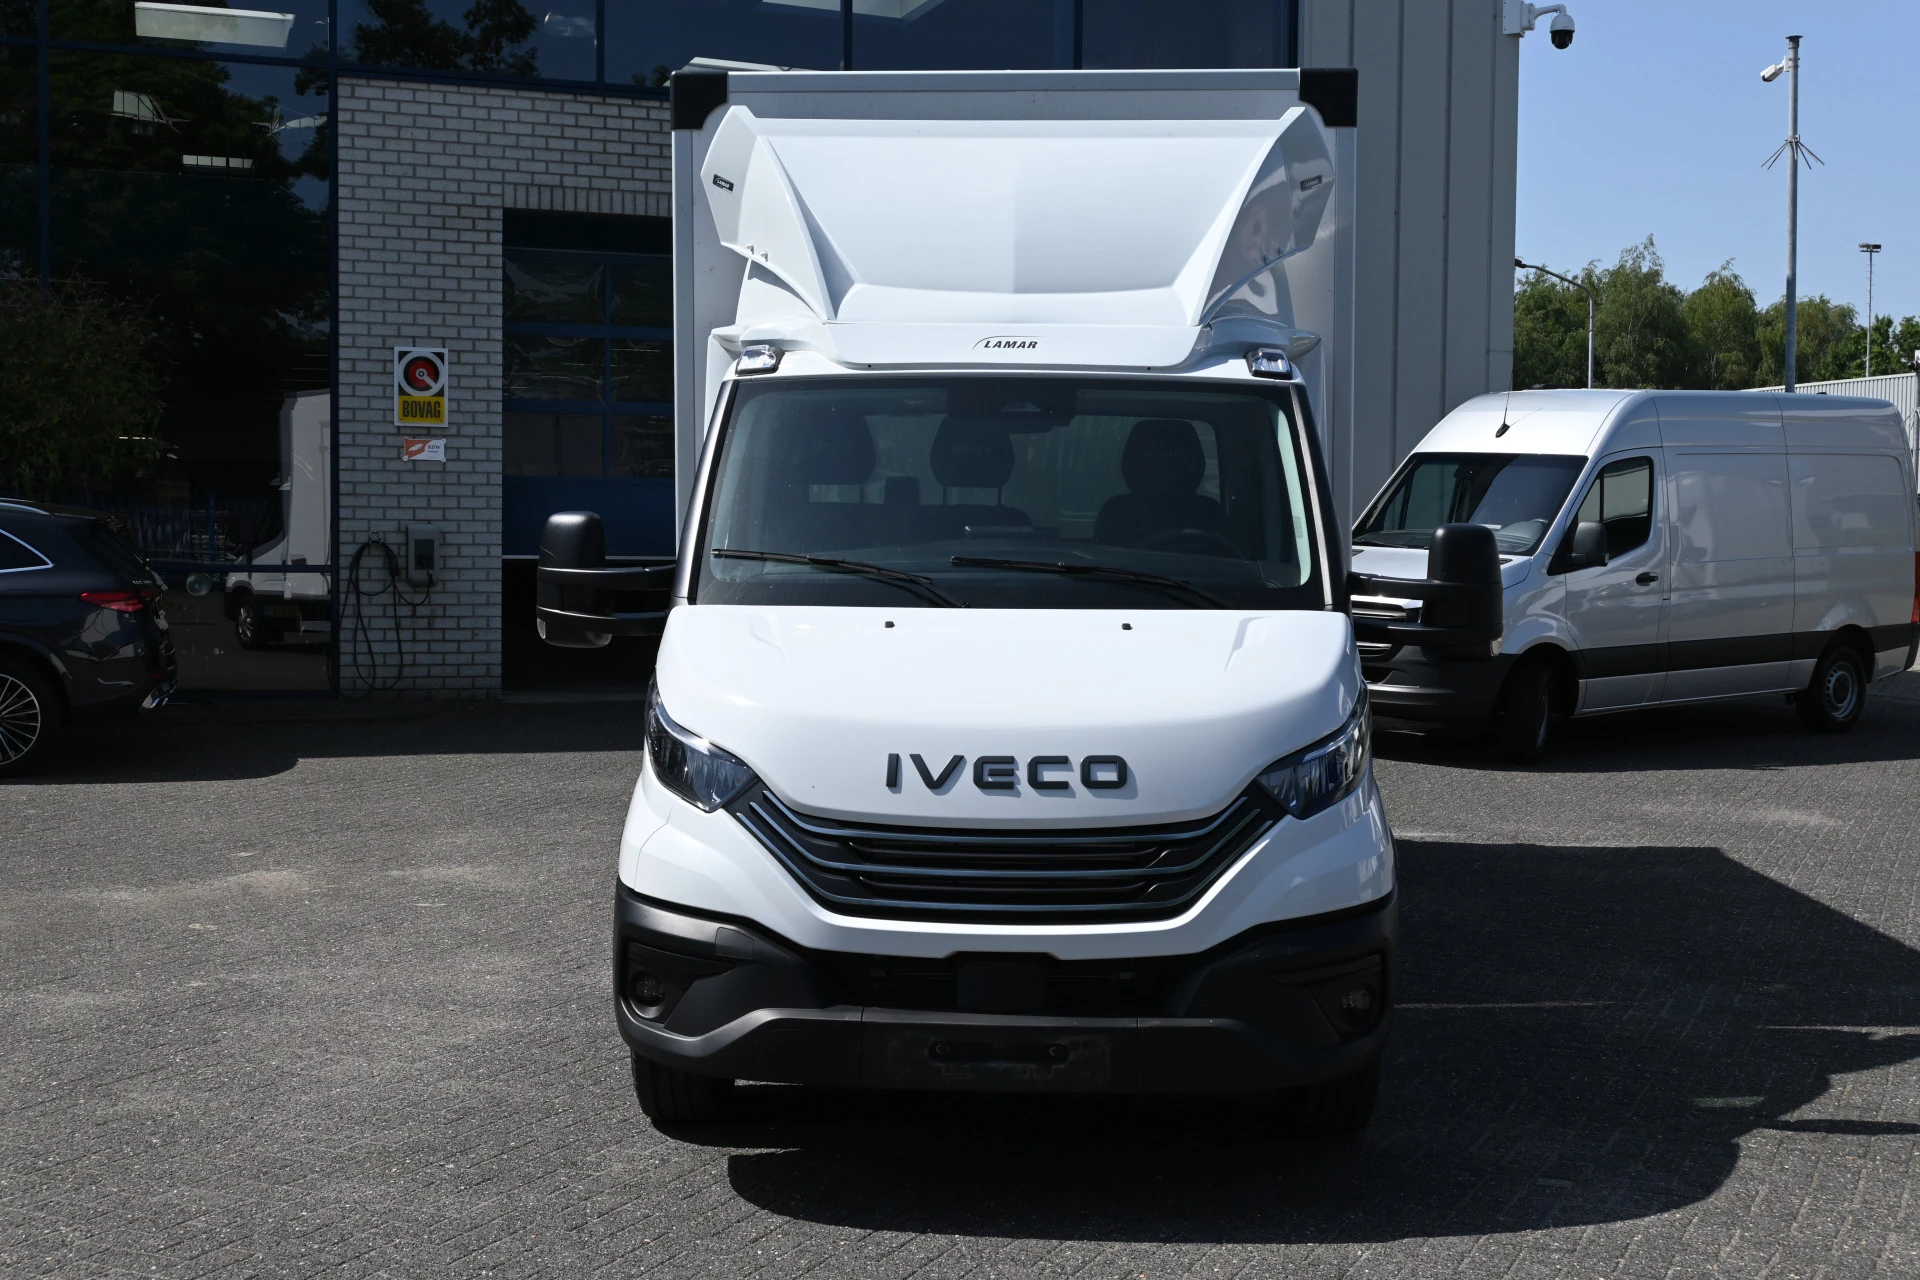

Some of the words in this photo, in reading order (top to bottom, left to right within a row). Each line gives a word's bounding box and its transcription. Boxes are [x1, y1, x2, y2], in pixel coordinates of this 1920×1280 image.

[983, 340, 1038, 349] LAMAR
[402, 400, 441, 418] BOVAG
[886, 753, 1128, 790] IVECO
